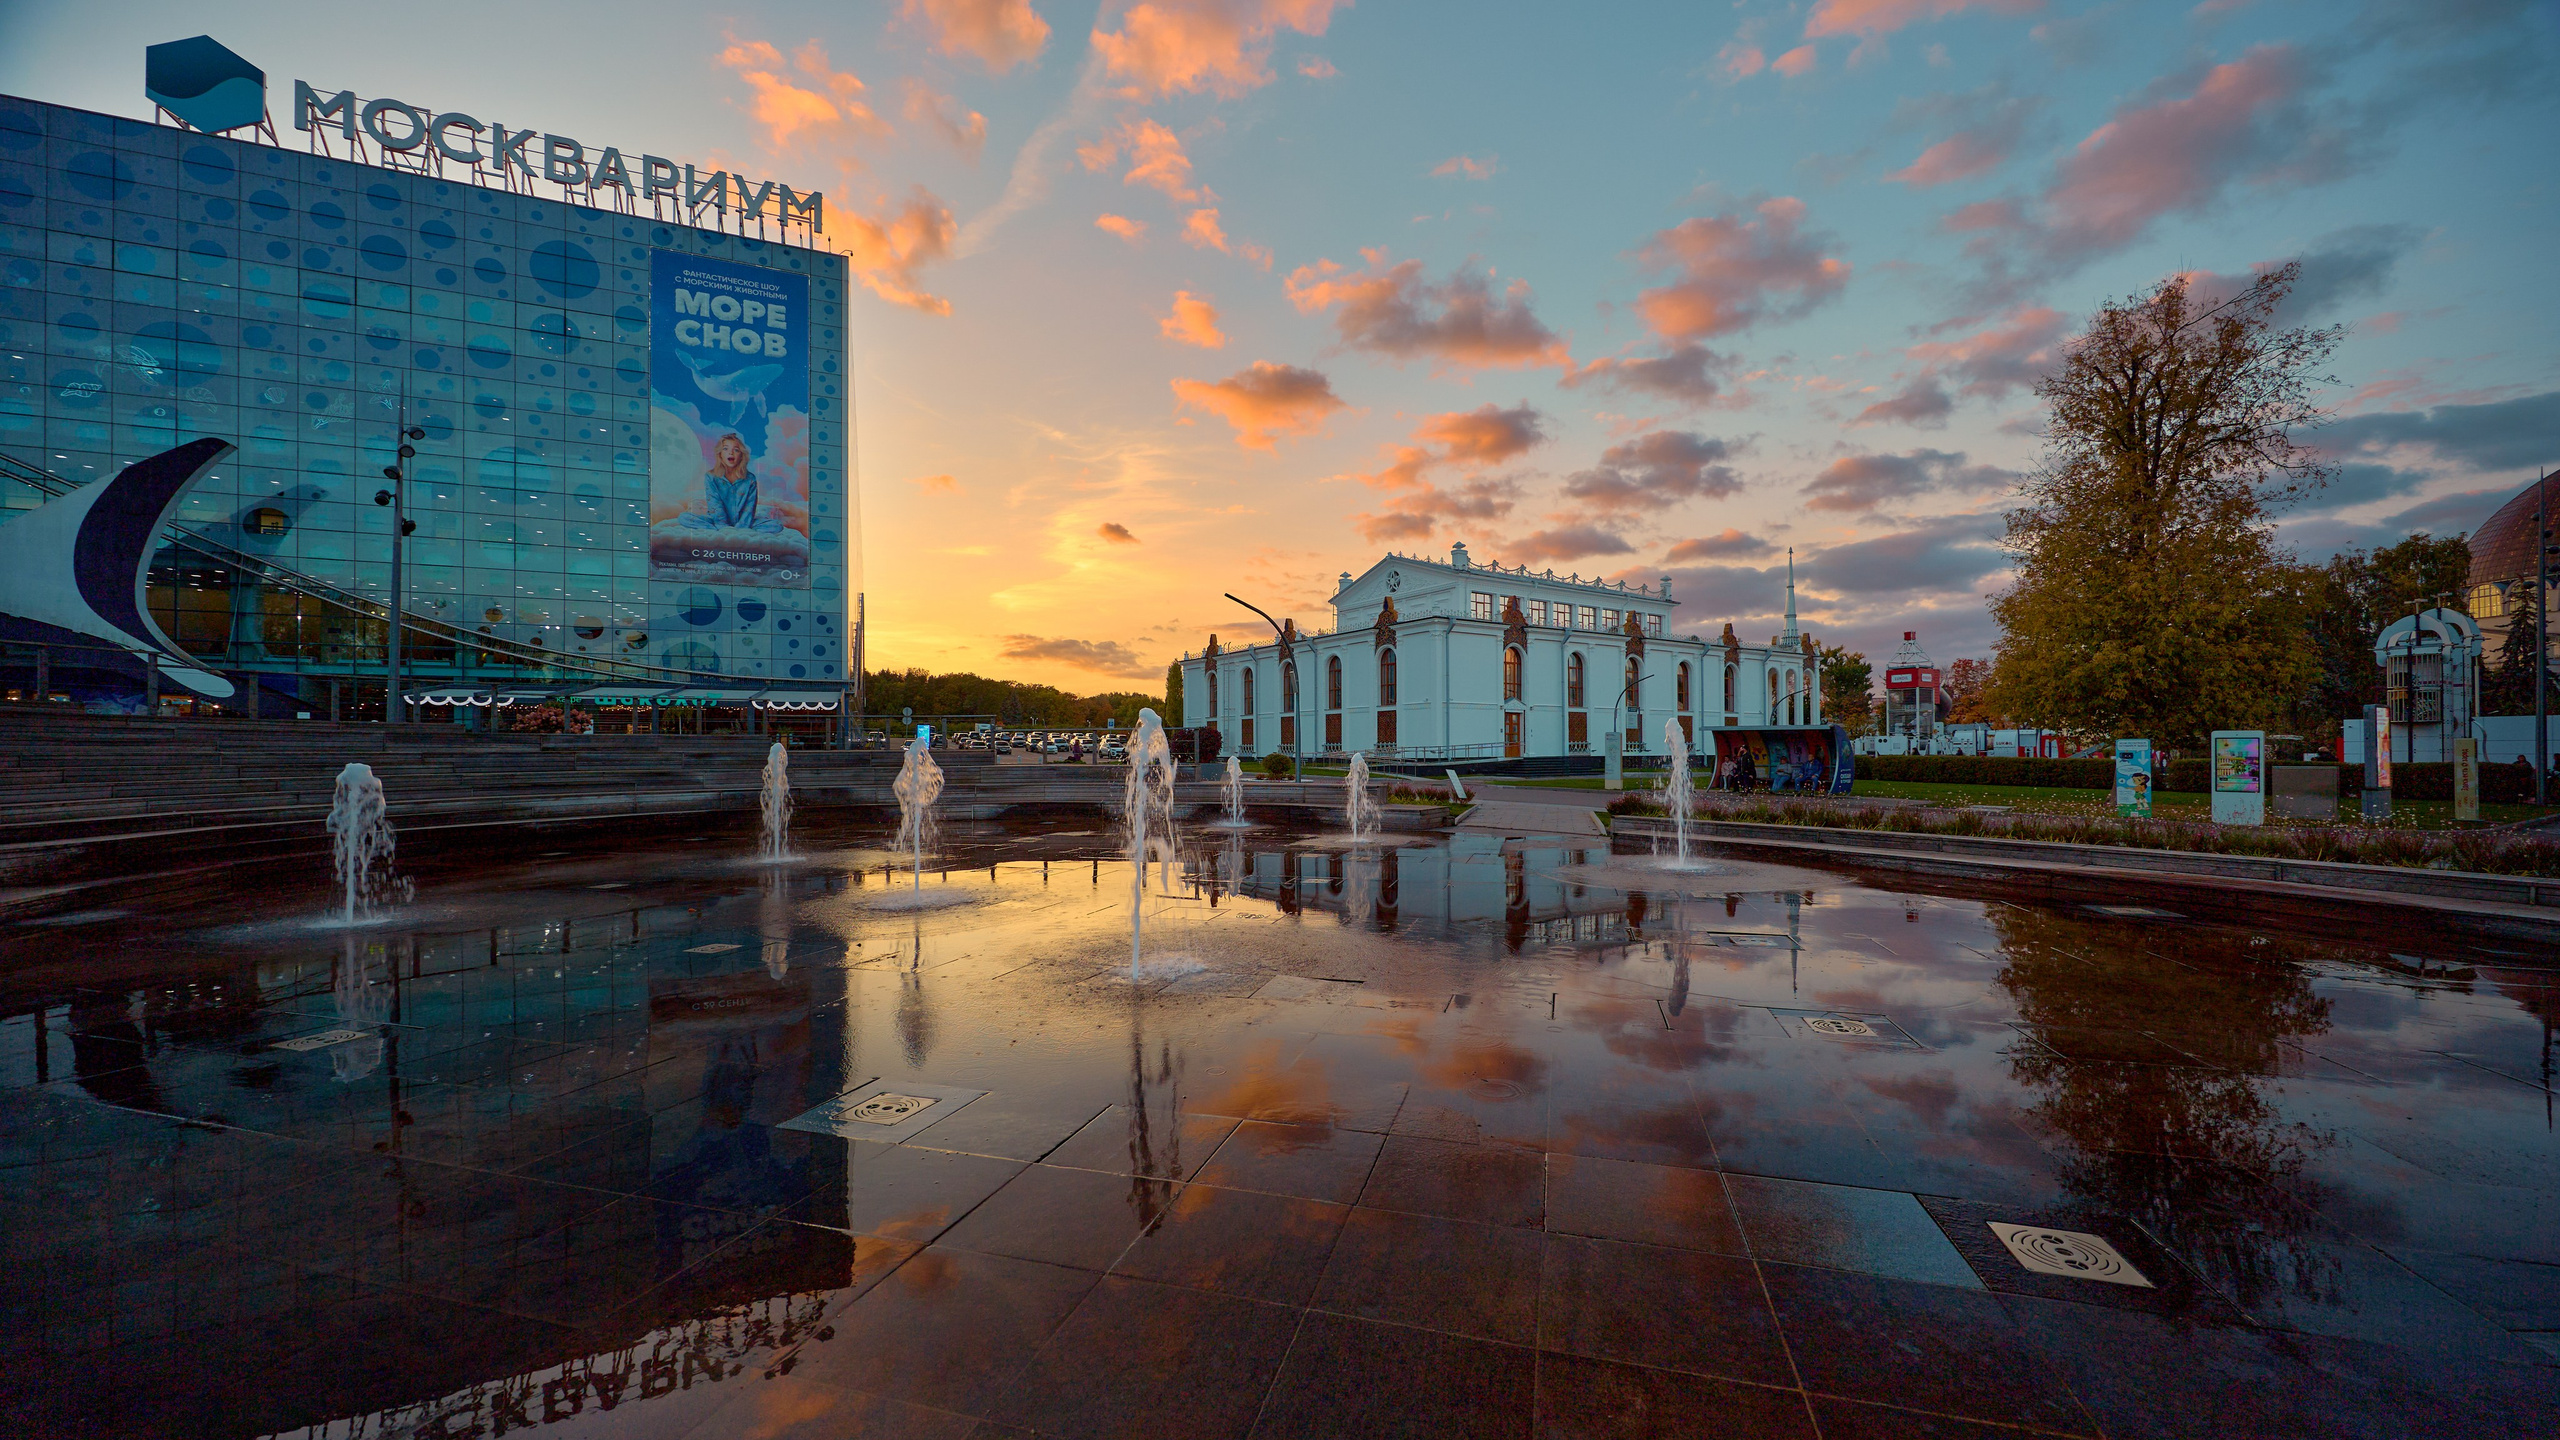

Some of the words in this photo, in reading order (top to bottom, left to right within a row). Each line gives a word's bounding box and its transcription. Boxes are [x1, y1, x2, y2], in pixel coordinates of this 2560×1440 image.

[294, 78, 823, 234] МОСКВАРИУМ
[683, 269, 760, 289] ФАНТАСТИЧЕСКОЕ
[760, 282, 781, 292] ШОУ
[683, 277, 733, 292] МОРСКИМИ
[734, 287, 788, 301] ЖИВОТНЫМИ
[675, 288, 787, 330] МОРЕ
[674, 319, 788, 358] СНОВ
[691, 548, 700, 557] С
[702, 549, 715, 559] 26
[717, 551, 771, 562] СЕНТЯБРЯ
[780, 569, 801, 580] 0+
